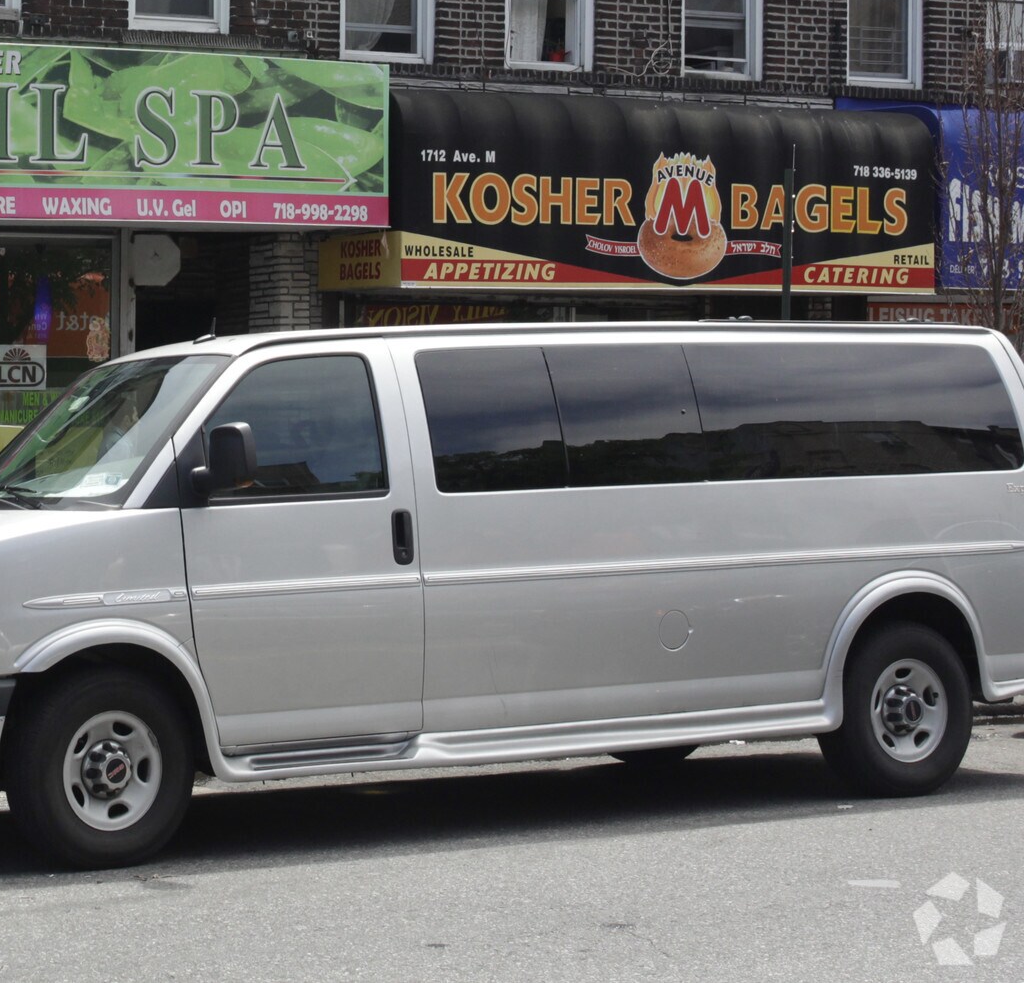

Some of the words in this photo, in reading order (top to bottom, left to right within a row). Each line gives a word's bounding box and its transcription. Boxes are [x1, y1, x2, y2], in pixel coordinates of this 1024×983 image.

[135, 86, 307, 170] SPA
[421, 150, 446, 162] 1712
[453, 150, 480, 163] Ave.
[485, 150, 496, 163] M
[656, 164, 715, 186] AVENUE
[853, 165, 870, 178] 718
[42, 197, 112, 216] WAXING
[137, 198, 168, 216] U.V.
[172, 200, 196, 217] Gel
[220, 200, 247, 218] OPI
[273, 202, 368, 221] 718-998-2298
[432, 172, 636, 226] KOSHER
[730, 183, 909, 236] BAGELS
[653, 176, 712, 238] M
[341, 239, 381, 259] KOSHER
[404, 245, 474, 258] WHOLESALE
[589, 239, 614, 253] CHOLOV
[615, 243, 638, 255] YISROEL
[730, 240, 756, 254] ישראל
[761, 241, 777, 255] חלב
[893, 254, 930, 266] RETAIL
[339, 261, 381, 281] BAGELS
[423, 262, 556, 281] APPETIZING
[803, 266, 909, 285] CATERING
[22, 393, 41, 407] MEN
[115, 591, 162, 603] Limited
